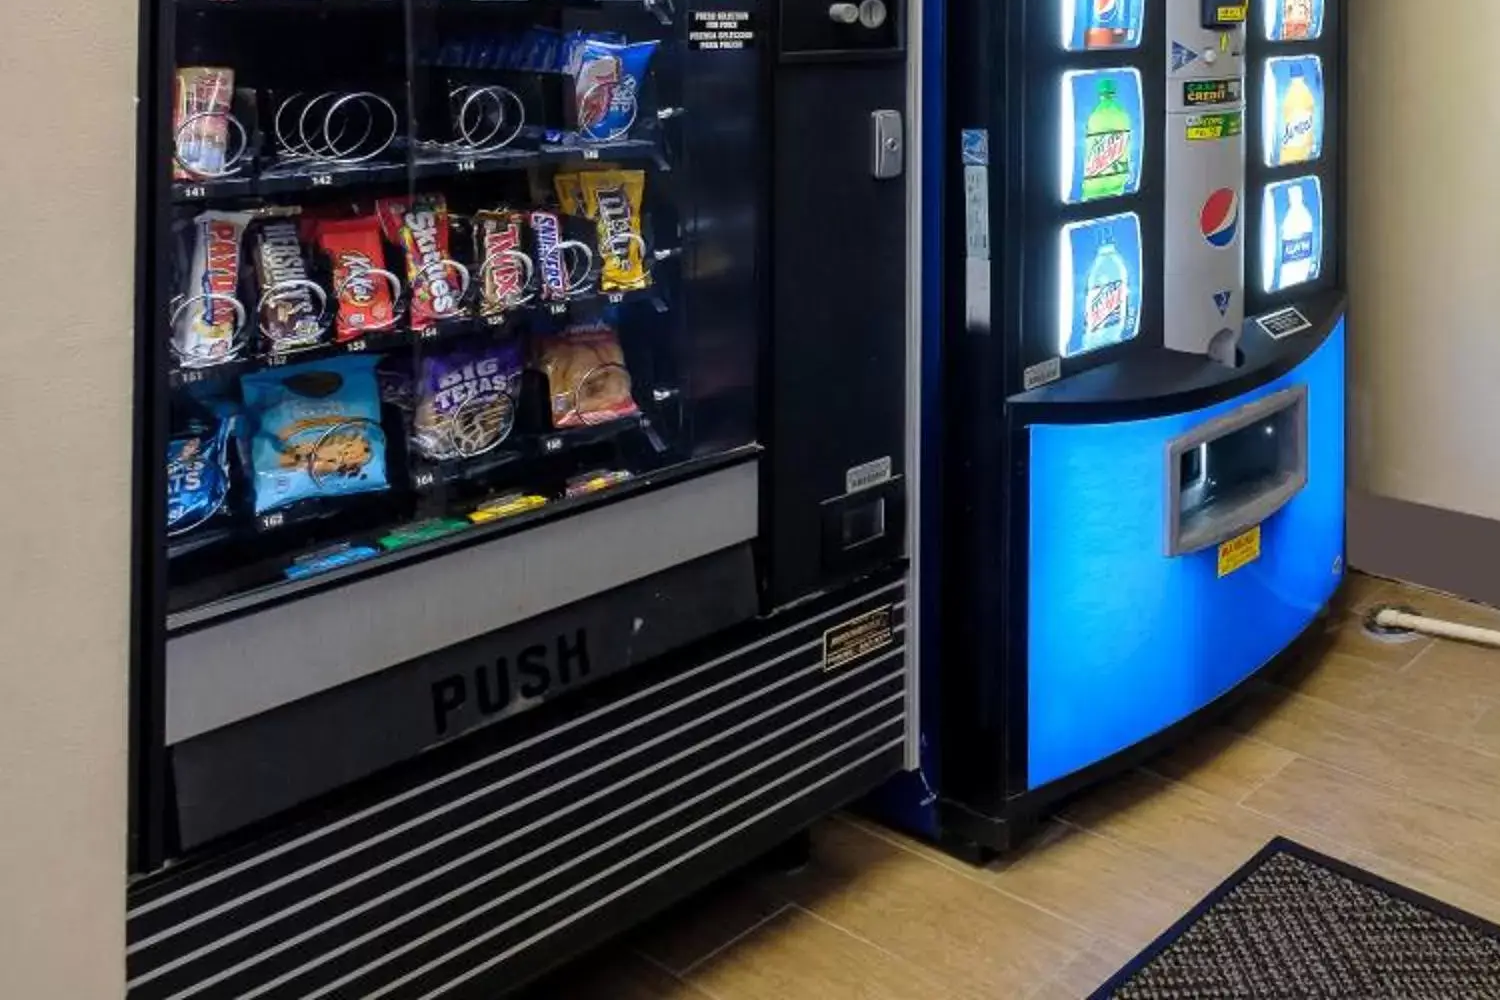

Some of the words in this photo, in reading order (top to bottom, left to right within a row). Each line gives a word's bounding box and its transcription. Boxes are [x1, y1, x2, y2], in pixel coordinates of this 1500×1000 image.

[185, 187, 205, 198] 141
[312, 175, 332, 186] 142
[439, 358, 499, 389] BIG
[435, 374, 508, 410] TEXAS
[431, 628, 590, 735] PUSH
